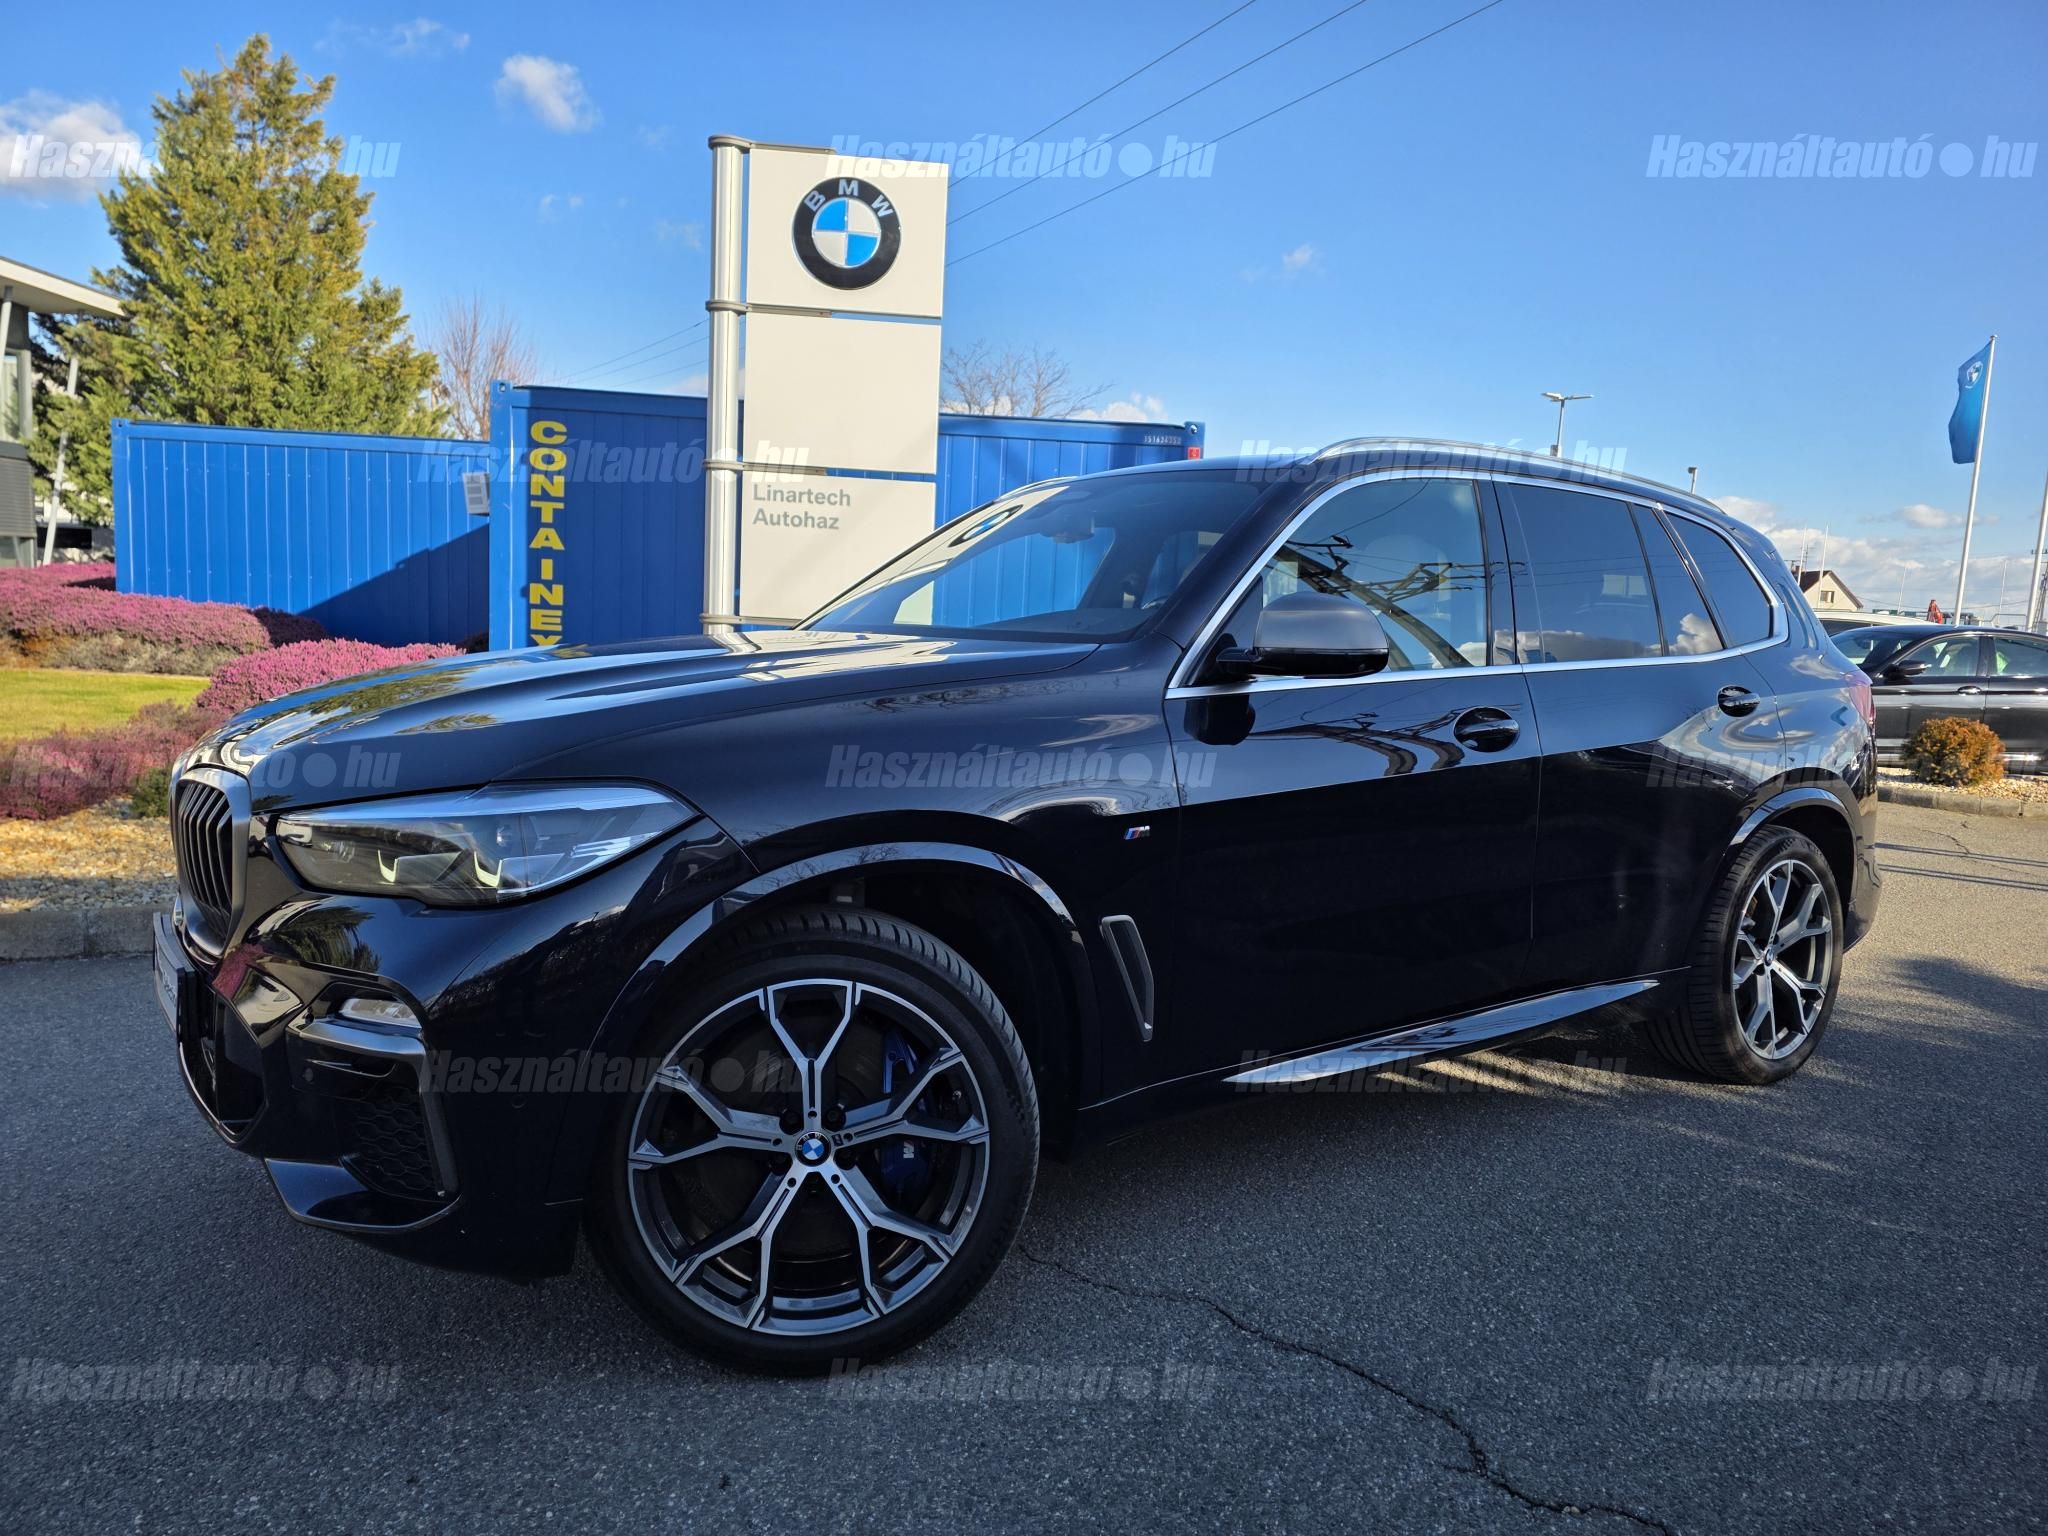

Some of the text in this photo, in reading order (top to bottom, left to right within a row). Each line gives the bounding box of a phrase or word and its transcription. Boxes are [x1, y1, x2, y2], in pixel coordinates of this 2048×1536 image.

[804, 179, 893, 217] BMW
[753, 483, 851, 506] Linartech
[752, 507, 839, 530] Autohaz
